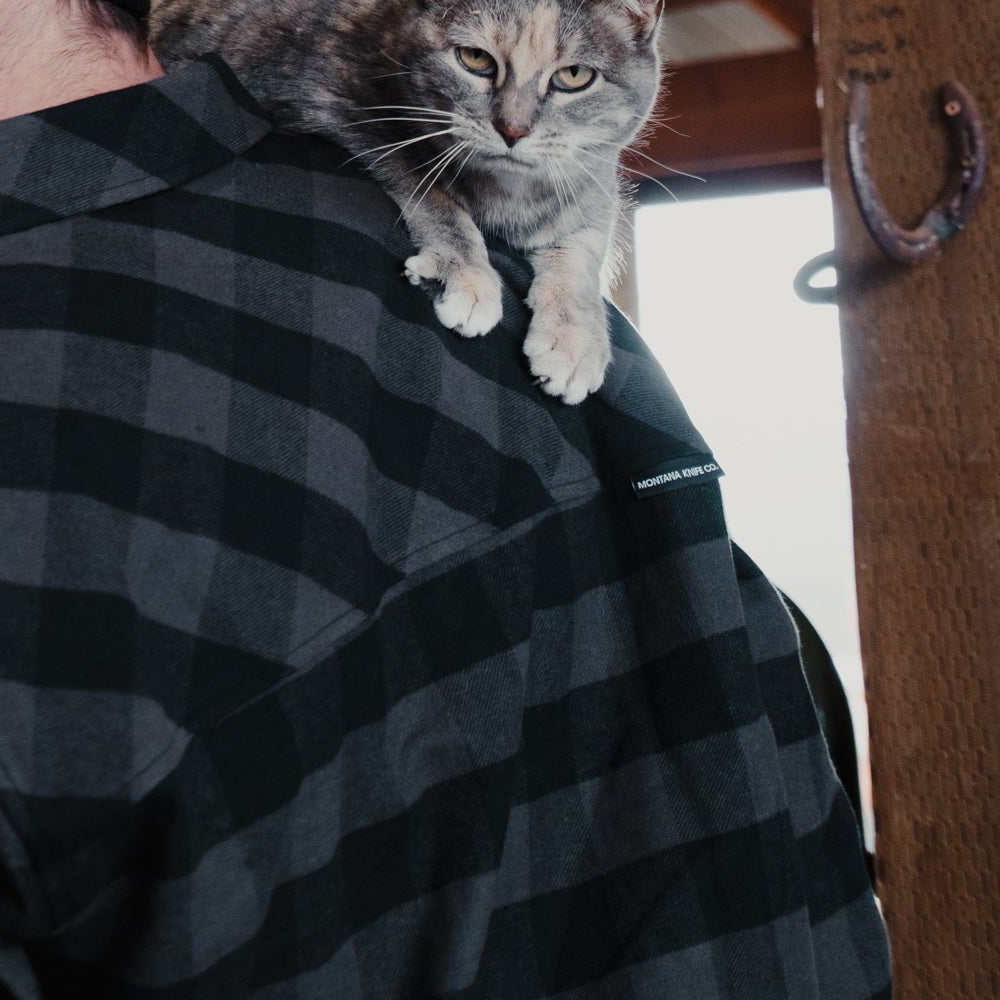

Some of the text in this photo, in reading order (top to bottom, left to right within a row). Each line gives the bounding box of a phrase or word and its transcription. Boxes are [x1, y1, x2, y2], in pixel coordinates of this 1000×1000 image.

[637, 463, 720, 489] MONTANA KNIFE CO.
